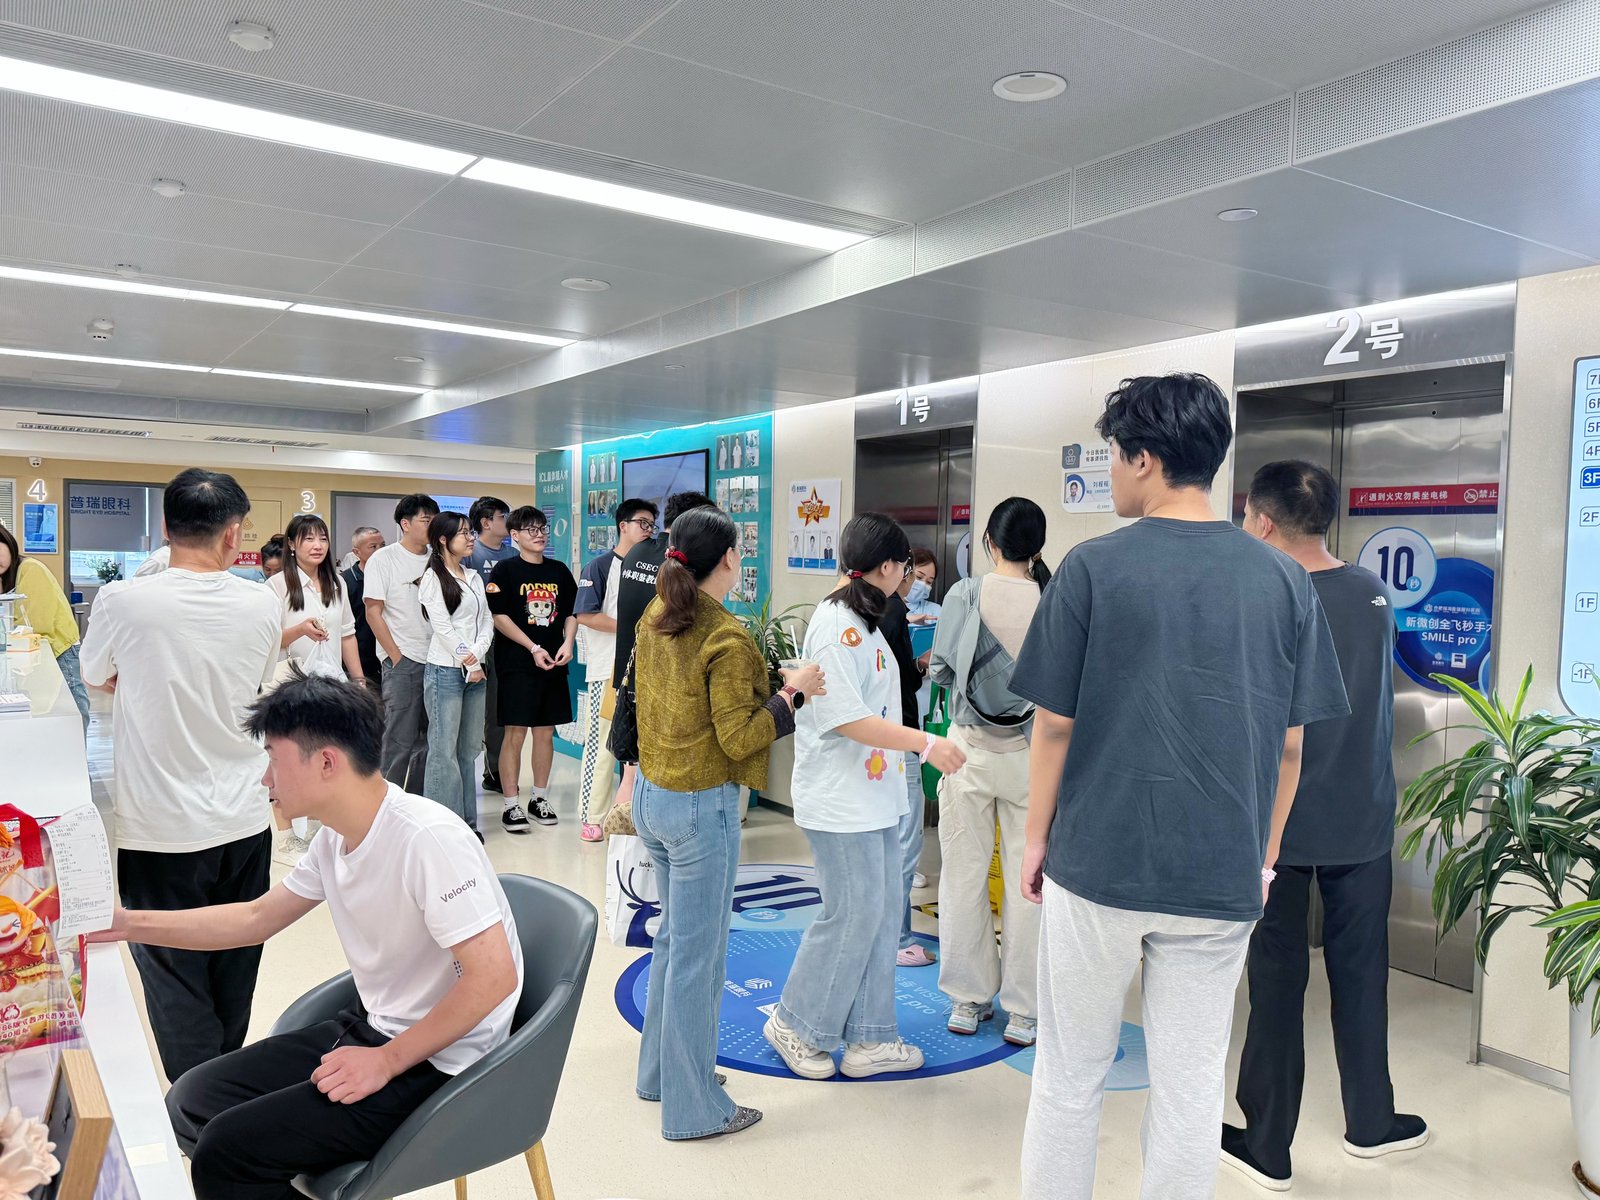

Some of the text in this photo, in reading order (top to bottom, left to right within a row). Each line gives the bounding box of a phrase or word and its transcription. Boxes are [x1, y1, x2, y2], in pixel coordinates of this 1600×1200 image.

[1323, 310, 1404, 366] 2号
[1590, 374, 1600, 386] 7
[895, 388, 931, 426] 1号
[1585, 445, 1600, 456] 4F
[1584, 472, 1600, 484] 3F
[27, 479, 47, 502] 4
[1368, 490, 1448, 502] 遇到火灾勿乘坐电梯
[1478, 489, 1498, 499] 禁止
[70, 495, 132, 510] 普瑞眼科
[301, 490, 316, 513] 3
[1582, 511, 1599, 523] 2F
[635, 560, 659, 572] CSEC
[1377, 545, 1414, 591] 10
[1410, 578, 1420, 590] 秒
[1578, 597, 1595, 608] 1F
[1421, 632, 1477, 646] SMILE pro
[440, 878, 477, 903] Velocity
